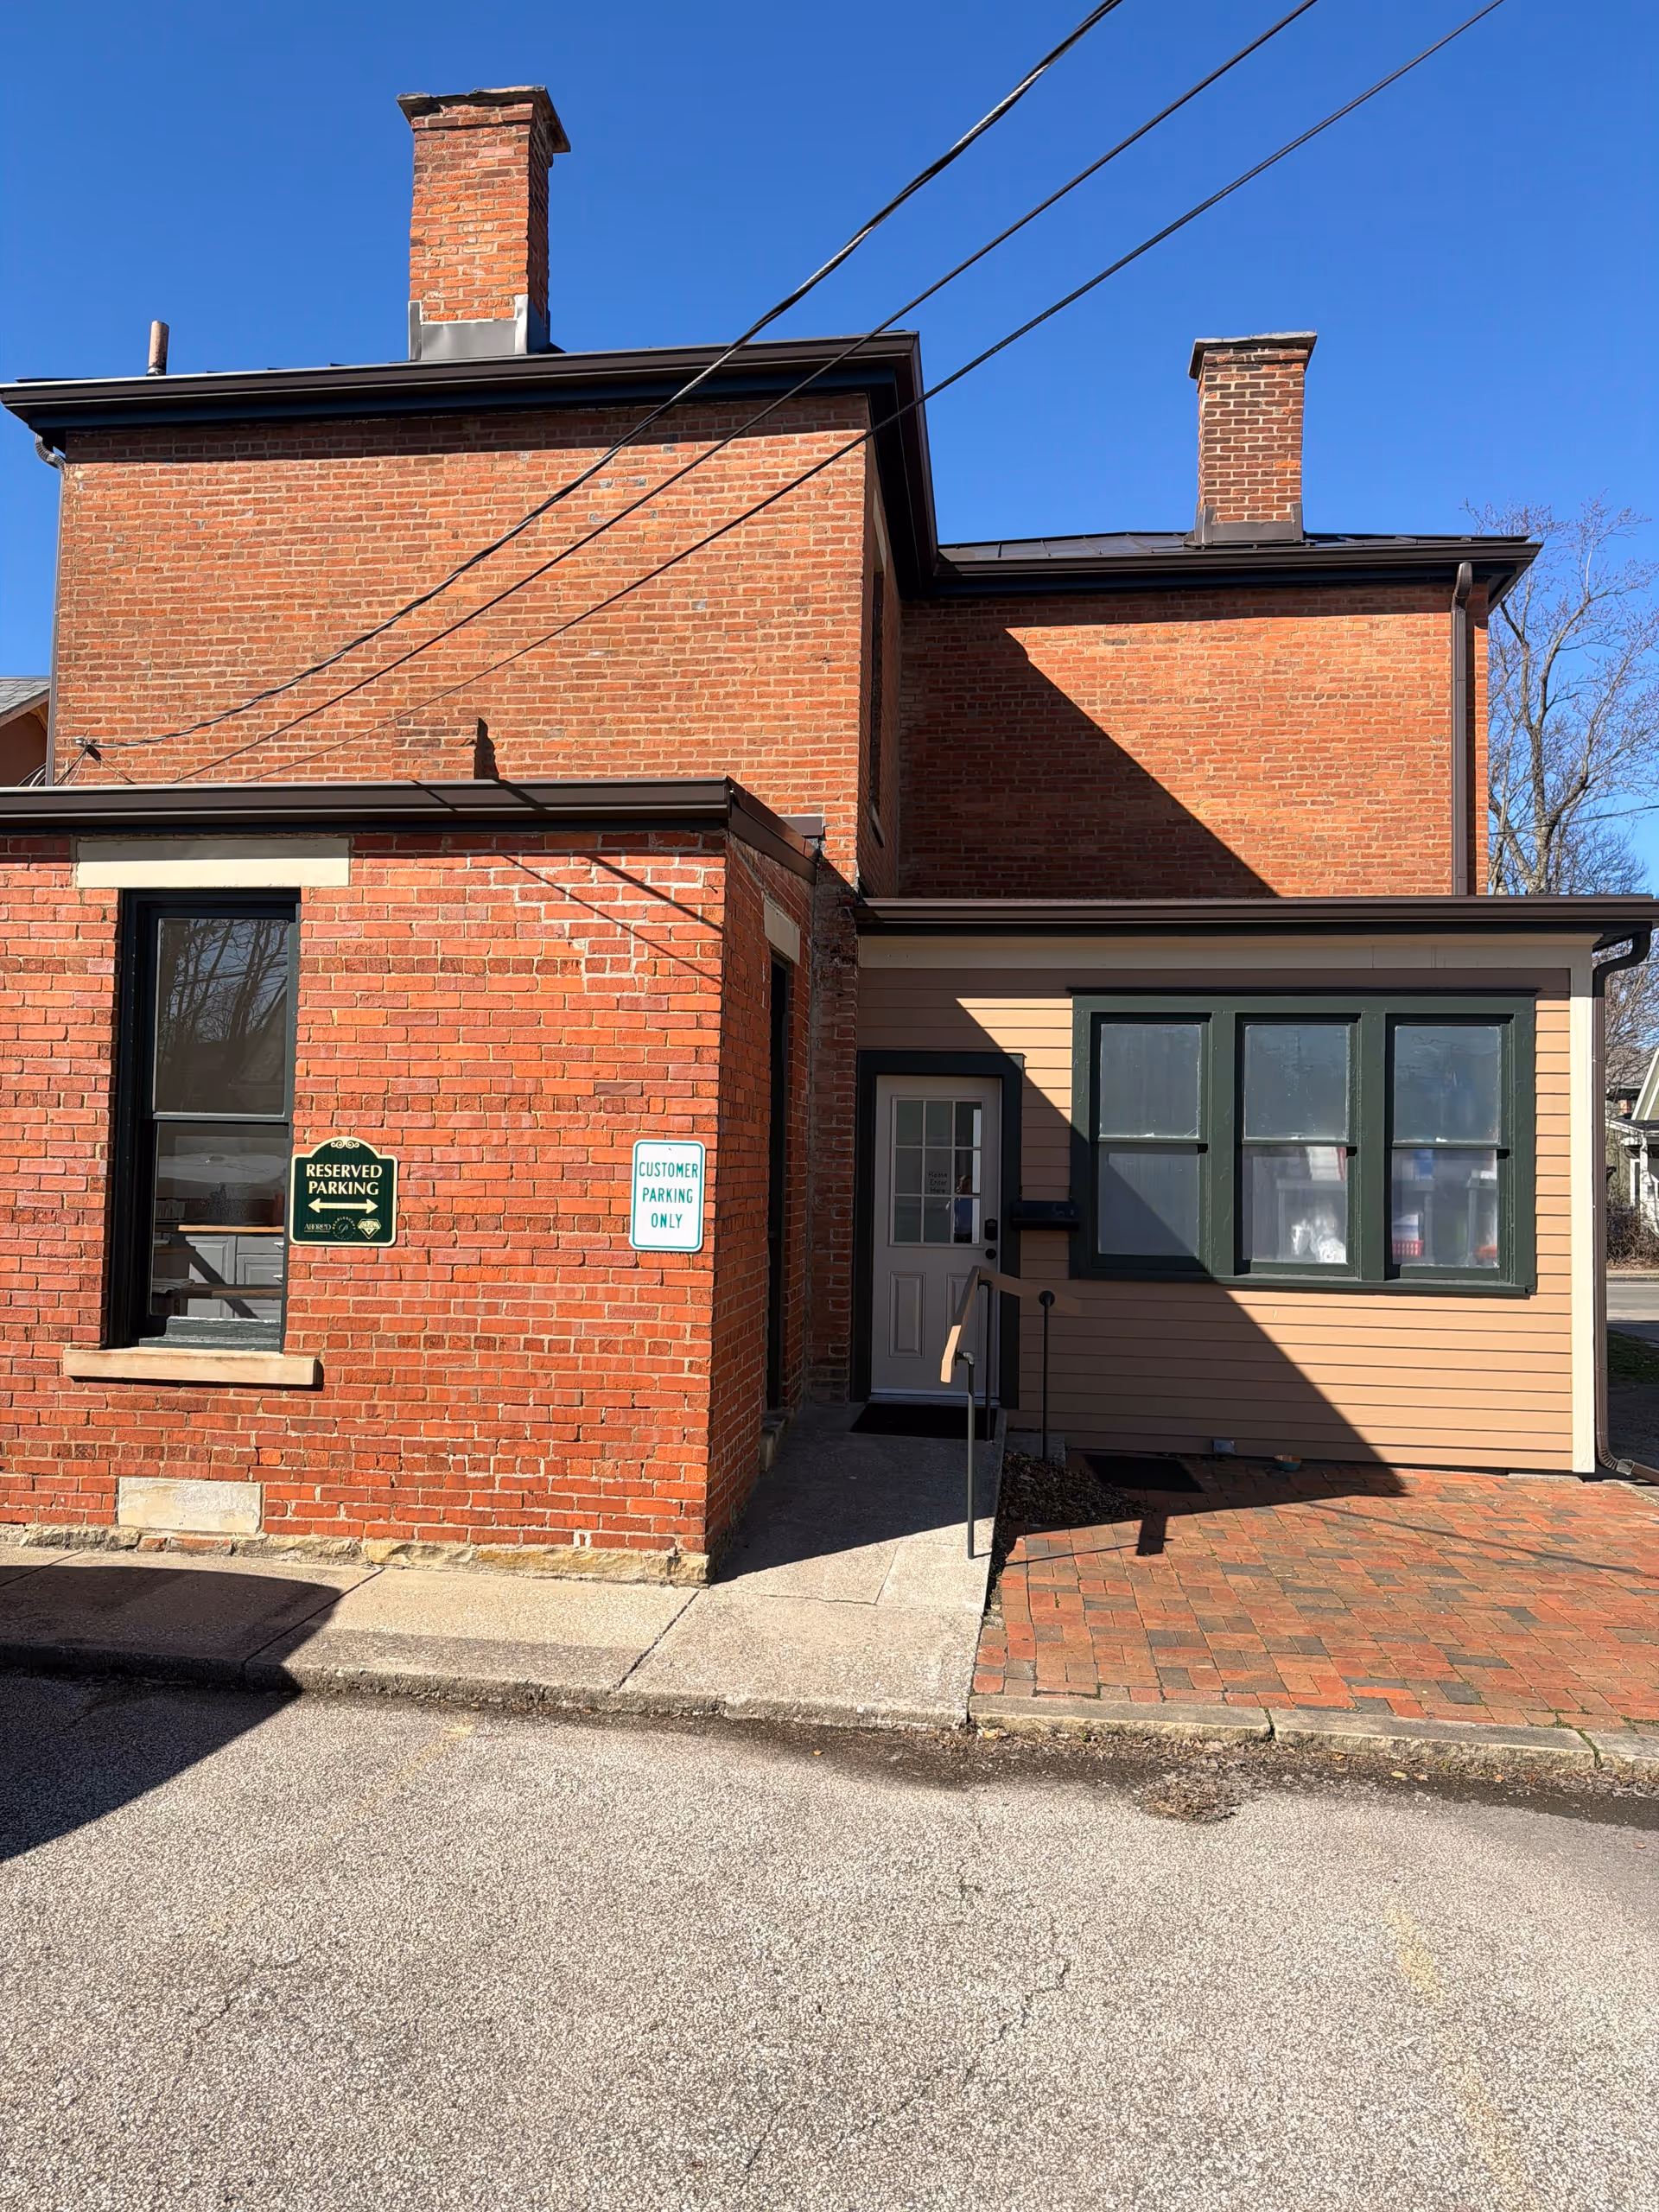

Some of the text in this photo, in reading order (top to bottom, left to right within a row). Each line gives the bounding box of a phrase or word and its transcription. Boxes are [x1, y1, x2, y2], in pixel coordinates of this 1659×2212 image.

[306, 1164, 383, 1179] RESERVED
[639, 1161, 698, 1178] CUSTOMER
[308, 1180, 379, 1196] PARKING
[642, 1187, 694, 1204] PARKING
[651, 1212, 683, 1229] ONLY
